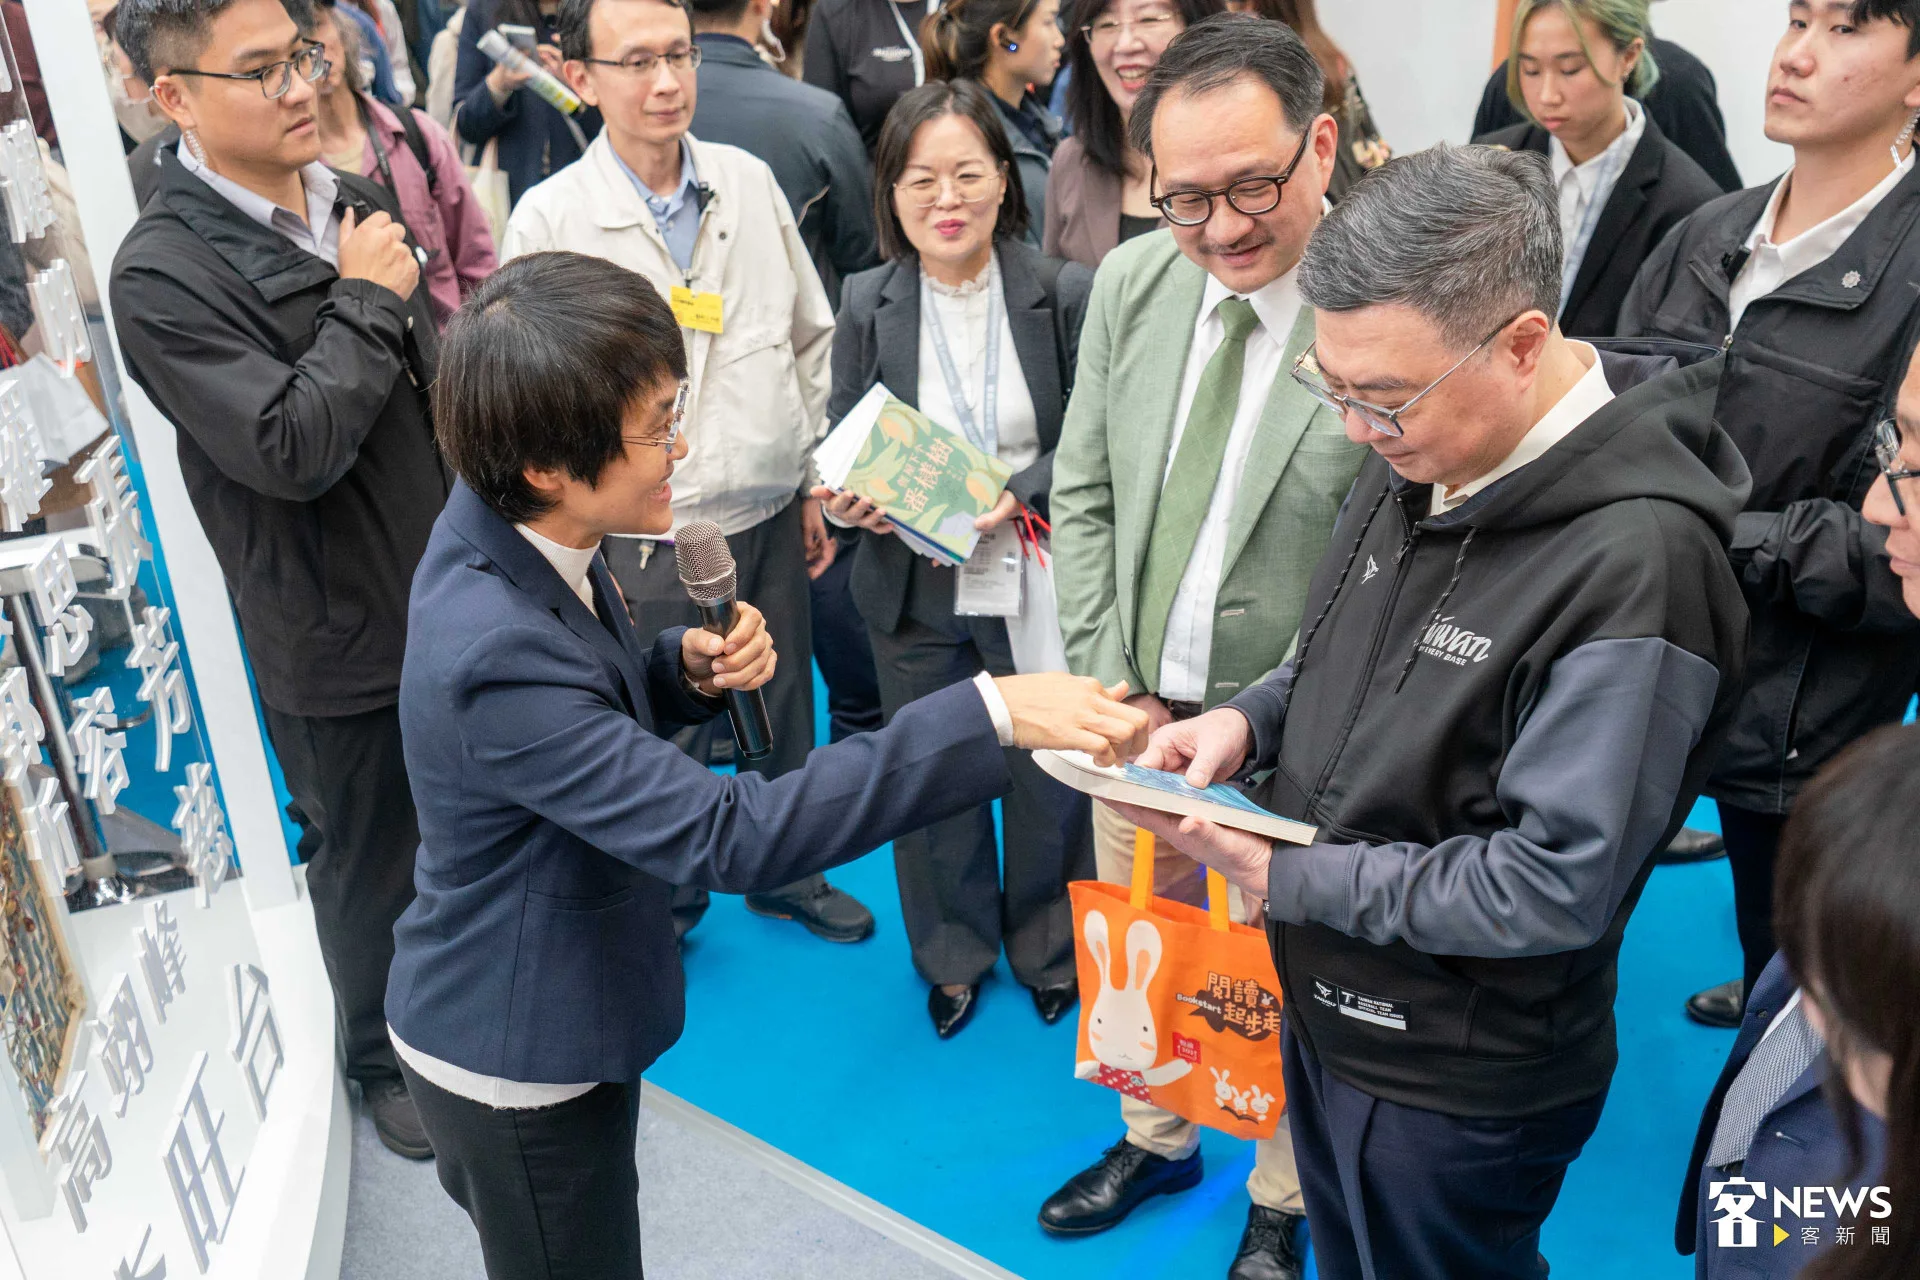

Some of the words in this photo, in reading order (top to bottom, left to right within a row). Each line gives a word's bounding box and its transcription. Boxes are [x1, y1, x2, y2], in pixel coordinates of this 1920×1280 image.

[1443, 653, 1467, 666] BASE
[1176, 992, 1222, 1015] Bookstart
[1207, 971, 1260, 1009] 閱讀
[1223, 1001, 1281, 1037] 起步走
